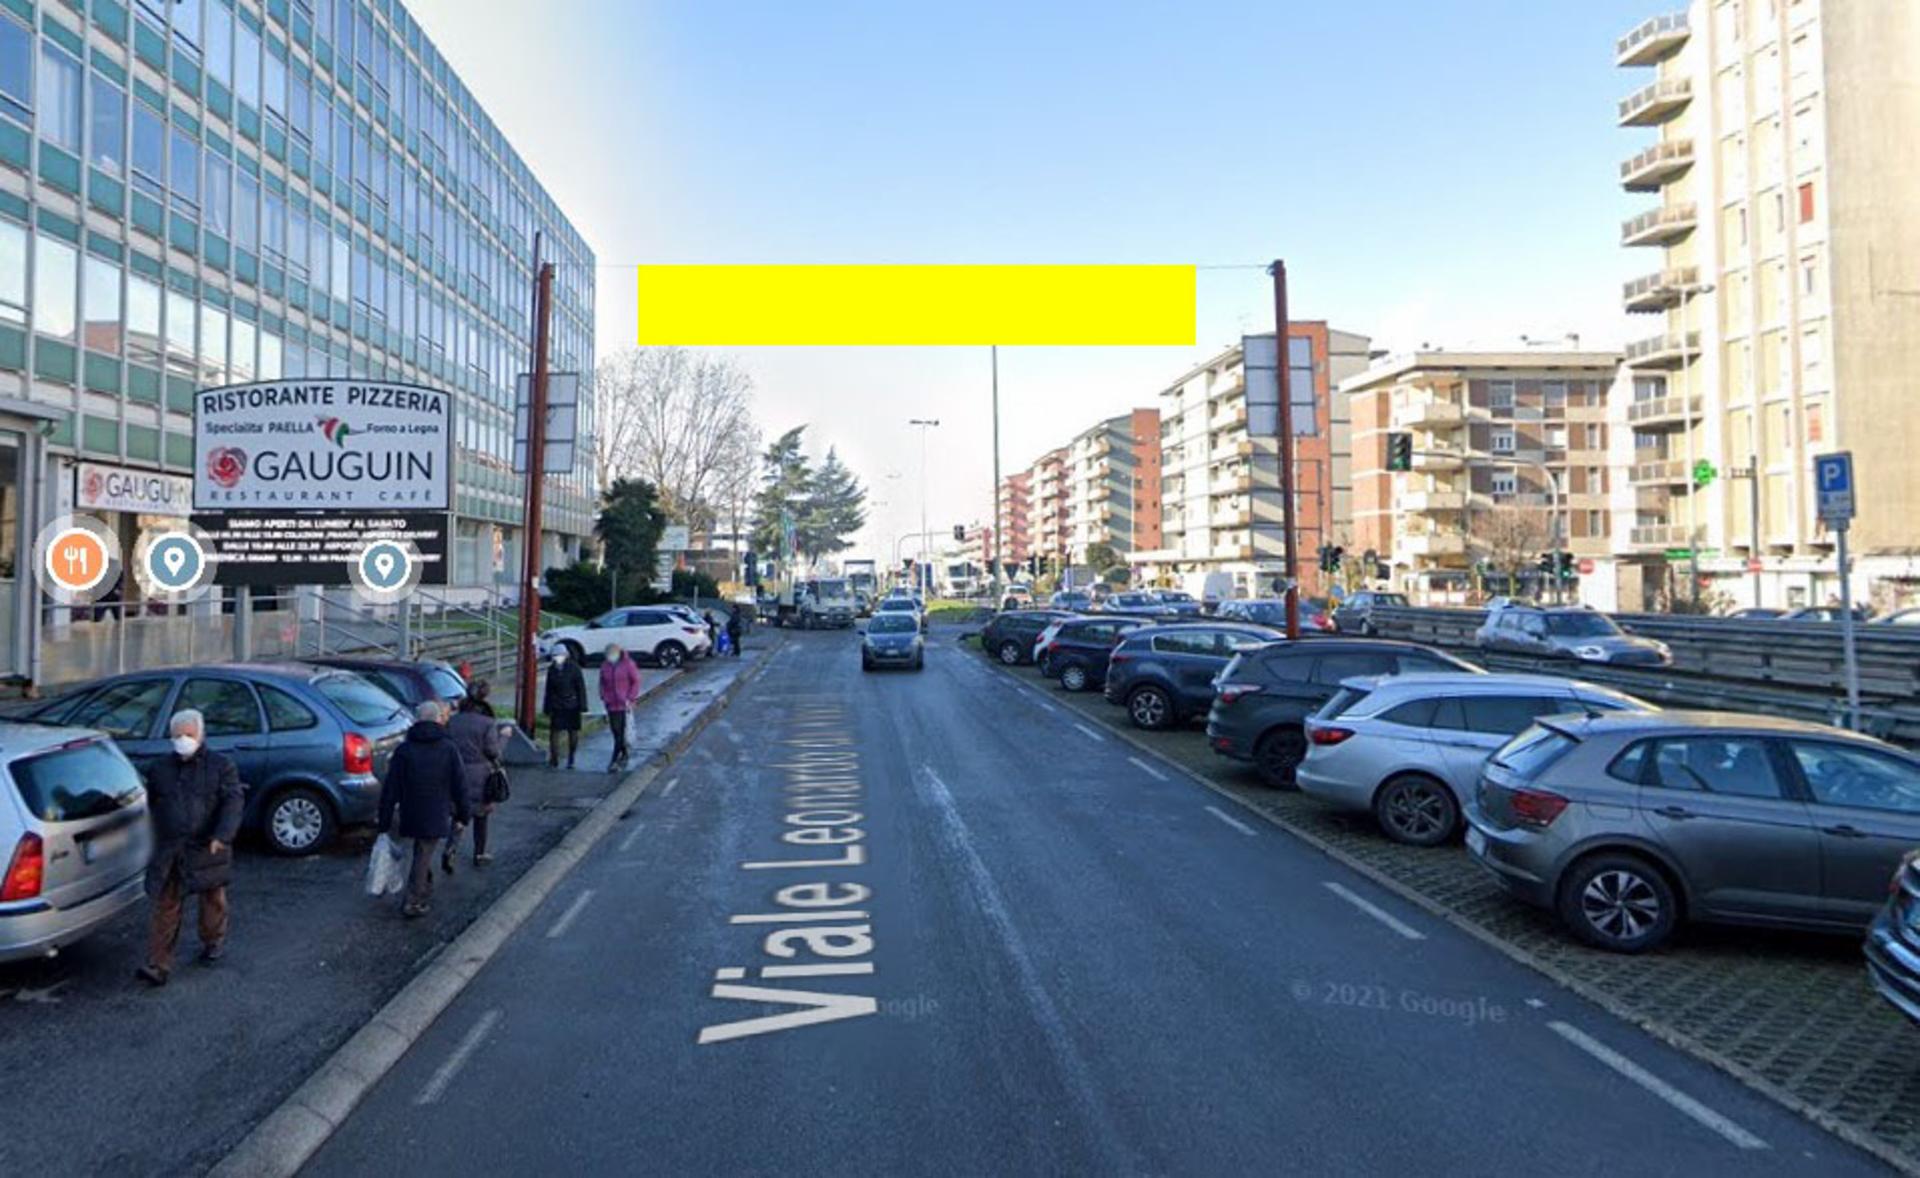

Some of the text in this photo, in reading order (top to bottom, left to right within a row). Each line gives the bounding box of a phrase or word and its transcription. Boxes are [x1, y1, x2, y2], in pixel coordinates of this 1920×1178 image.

[203, 386, 443, 415] RISTORANTE PIZZERIA
[268, 421, 315, 434] PAELLA
[366, 422, 440, 435] Forno a Legna
[253, 450, 433, 481] GAUGUIN
[1824, 463, 1841, 490] P
[209, 491, 354, 501] RESTAURANT
[353, 519, 365, 529] AL
[368, 519, 406, 529] SABATO
